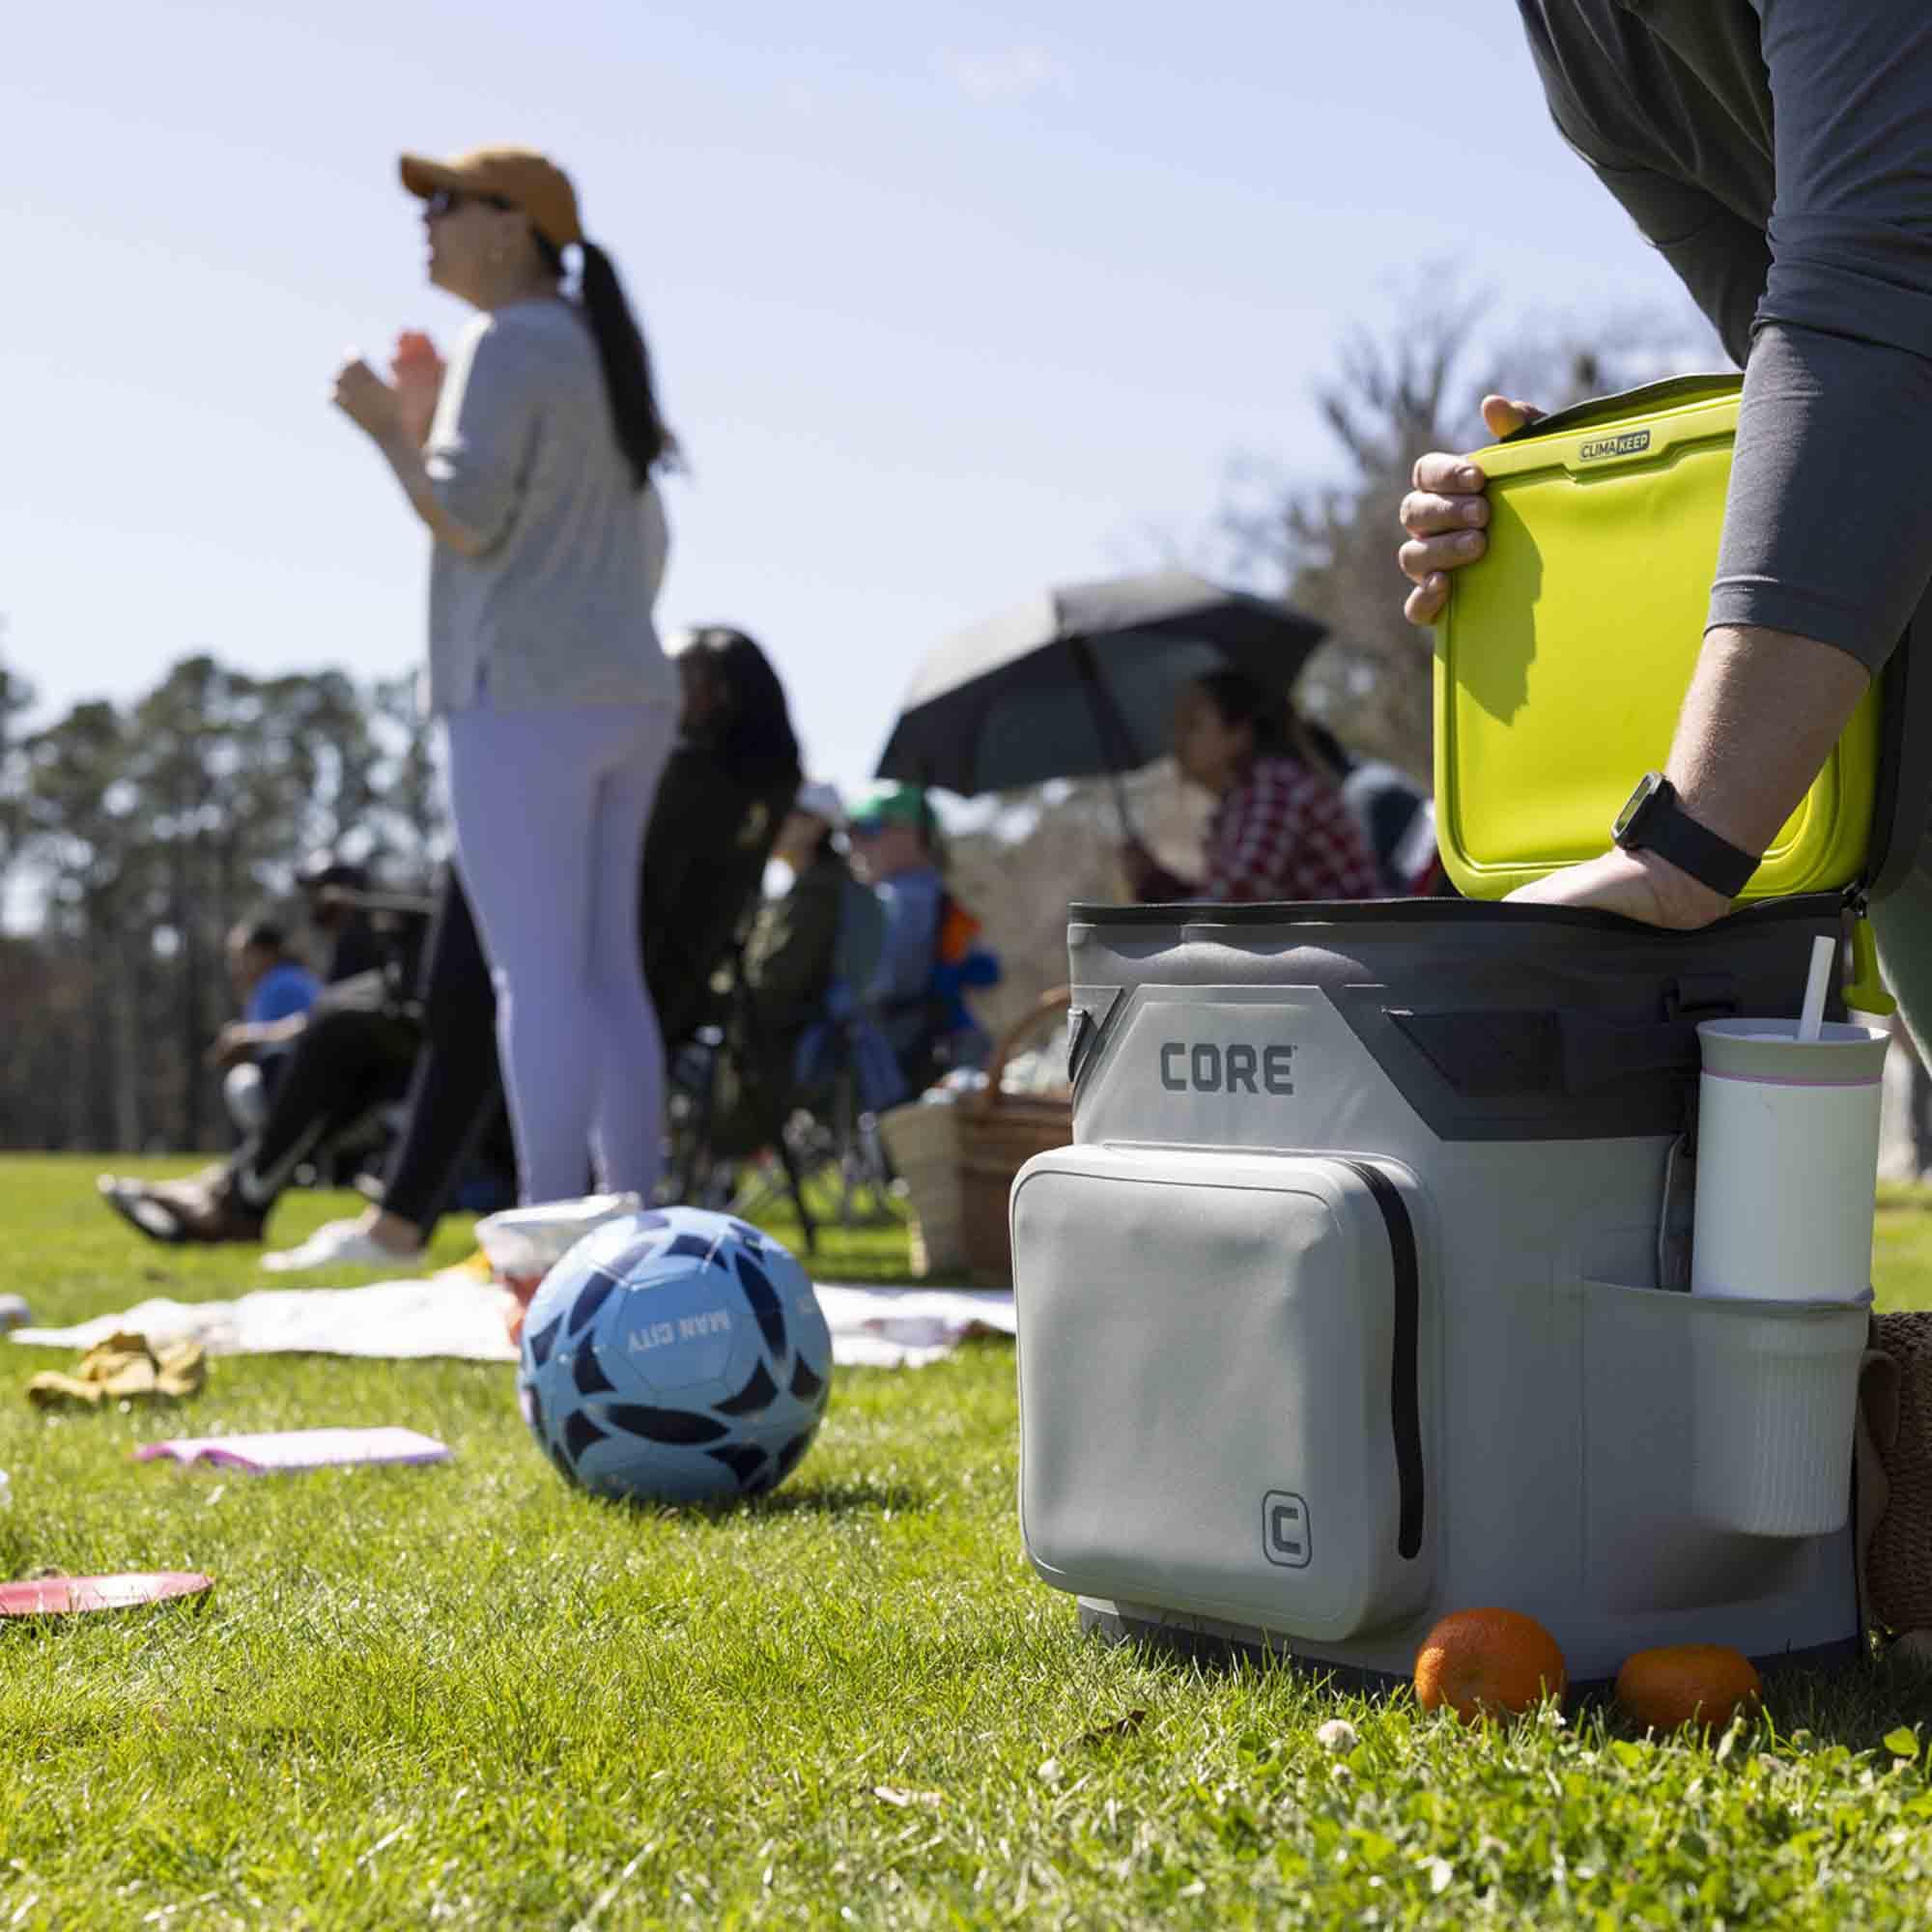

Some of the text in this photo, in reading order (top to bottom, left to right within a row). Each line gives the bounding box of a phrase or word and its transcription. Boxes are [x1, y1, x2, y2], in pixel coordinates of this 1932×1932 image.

[1160, 1042, 1294, 1094] CORE
[628, 1310, 730, 1353] MAN CITY
